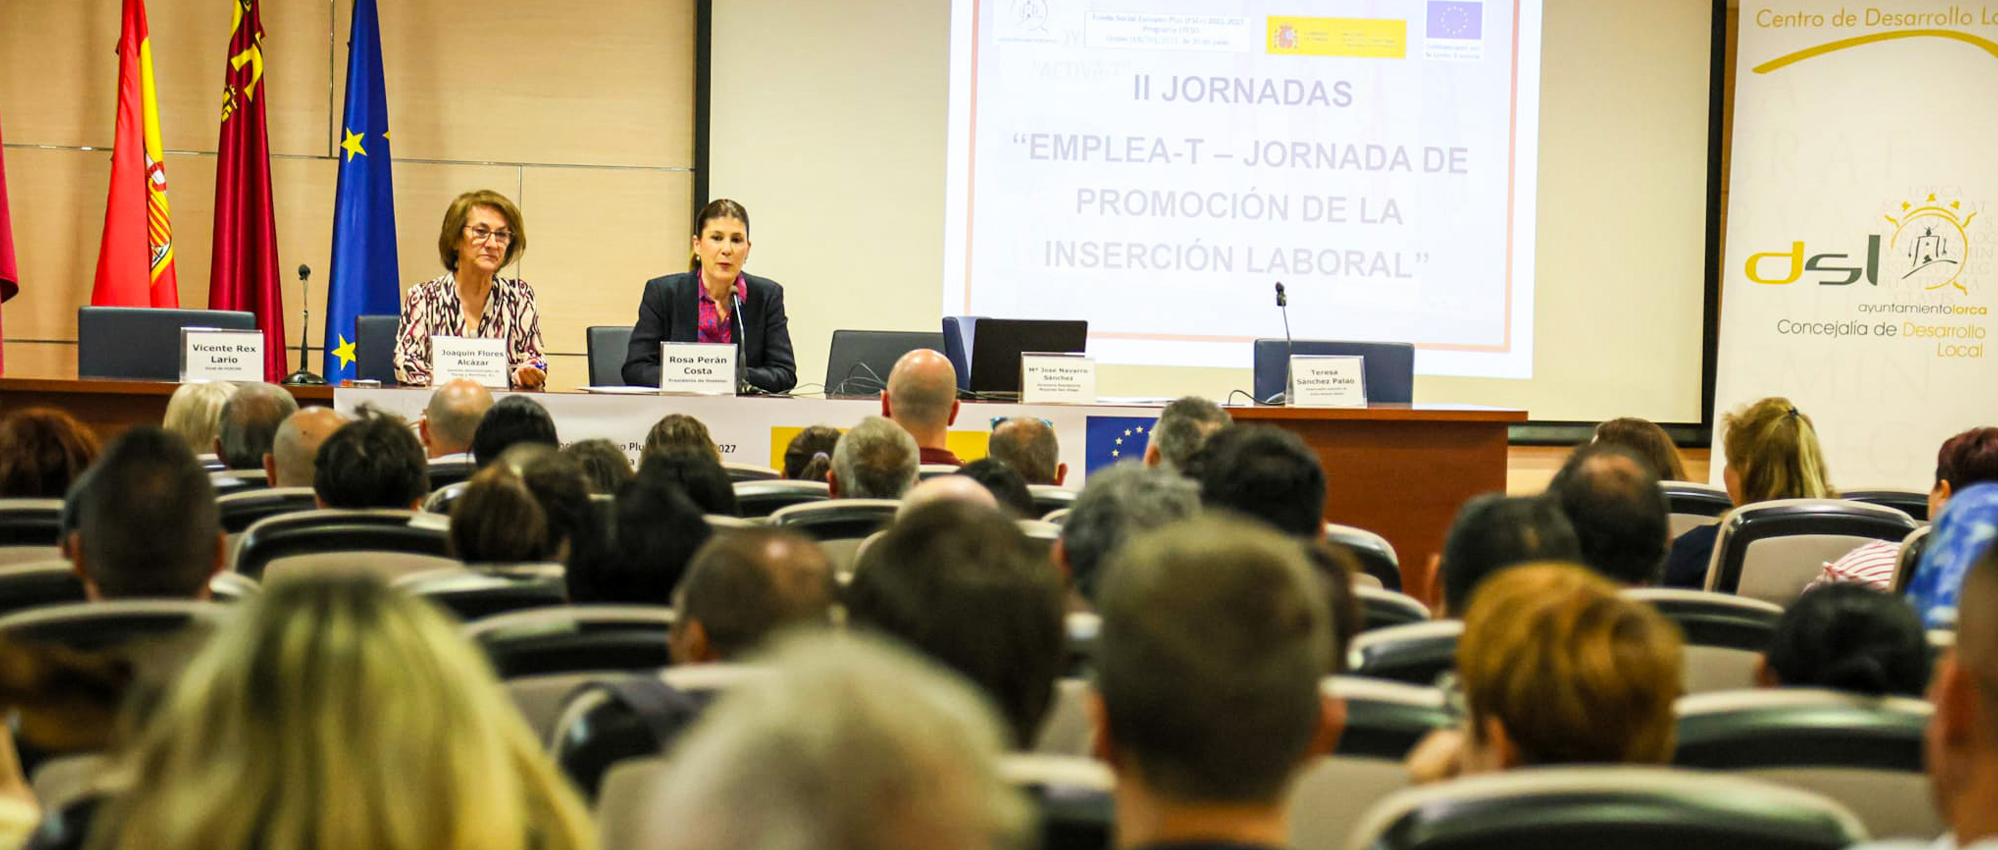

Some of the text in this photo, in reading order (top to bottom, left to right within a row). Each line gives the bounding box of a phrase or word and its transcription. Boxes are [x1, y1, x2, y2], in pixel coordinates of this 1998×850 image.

[1756, 8, 1824, 28] Centro
[1833, 7, 1858, 27] de
[1865, 5, 1974, 26] Desarrollo
[1133, 75, 1354, 108] II JORNADAS
[1012, 133, 1205, 166] “EMPLEA-T
[1242, 140, 1413, 173] JORNADA
[1423, 147, 1470, 175] DE
[1076, 187, 1404, 226] PROMOCIÓN DE LA
[1044, 238, 1431, 280] INSERCIÓN LABORAL”
[1744, 234, 1881, 287] dsl
[1777, 319, 1987, 340] Concejalía de Desarrollo
[192, 344, 257, 353] Vicente Rex
[477, 350, 505, 358] Flores
[1936, 343, 1984, 359] Local
[211, 356, 238, 364] Lario
[669, 355, 728, 364] Rosa Perán
[683, 367, 713, 375] Costa
[1311, 369, 1339, 377] Teresa
[628, 442, 645, 452] Plu
